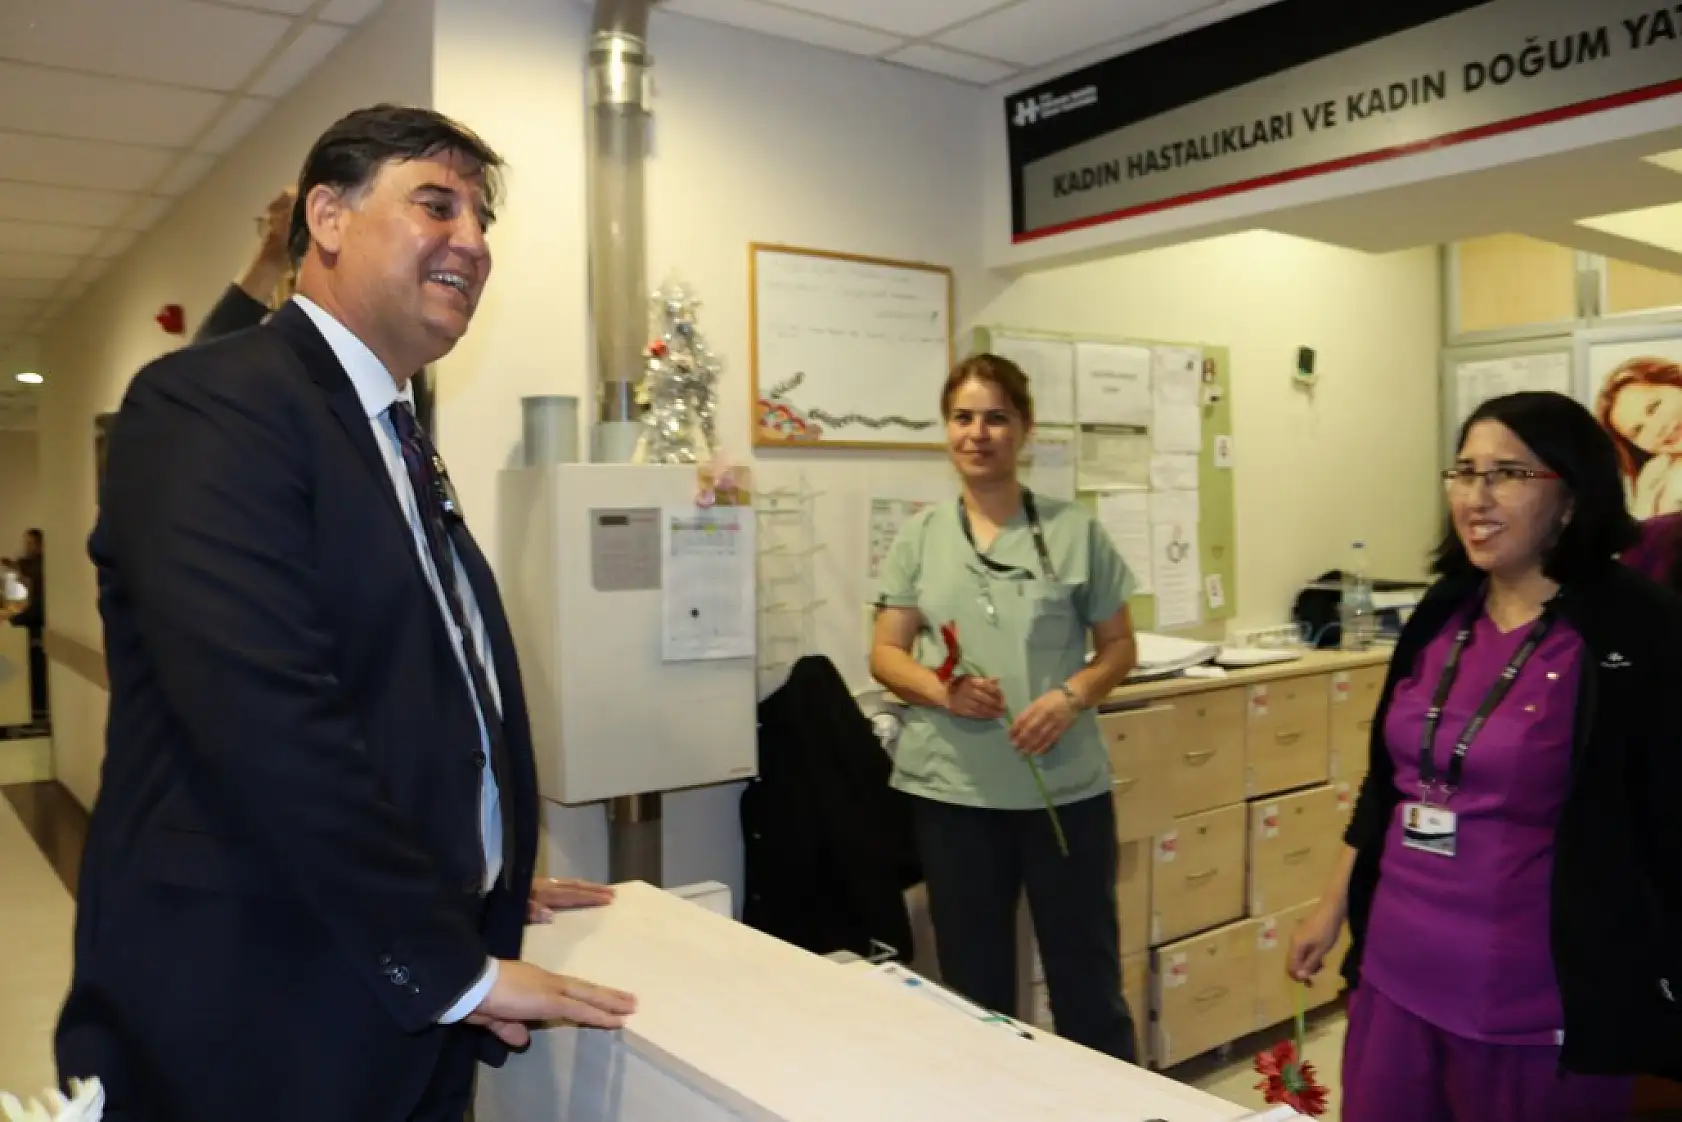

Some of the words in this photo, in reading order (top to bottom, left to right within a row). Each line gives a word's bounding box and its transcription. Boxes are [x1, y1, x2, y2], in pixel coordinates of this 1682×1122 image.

[1053, 158, 1121, 197] KADIN
[1126, 111, 1294, 180] HASTALIKLARI
[1301, 100, 1337, 132] VE
[1346, 70, 1446, 122] KADIN
[1464, 26, 1611, 93] DOĞUM
